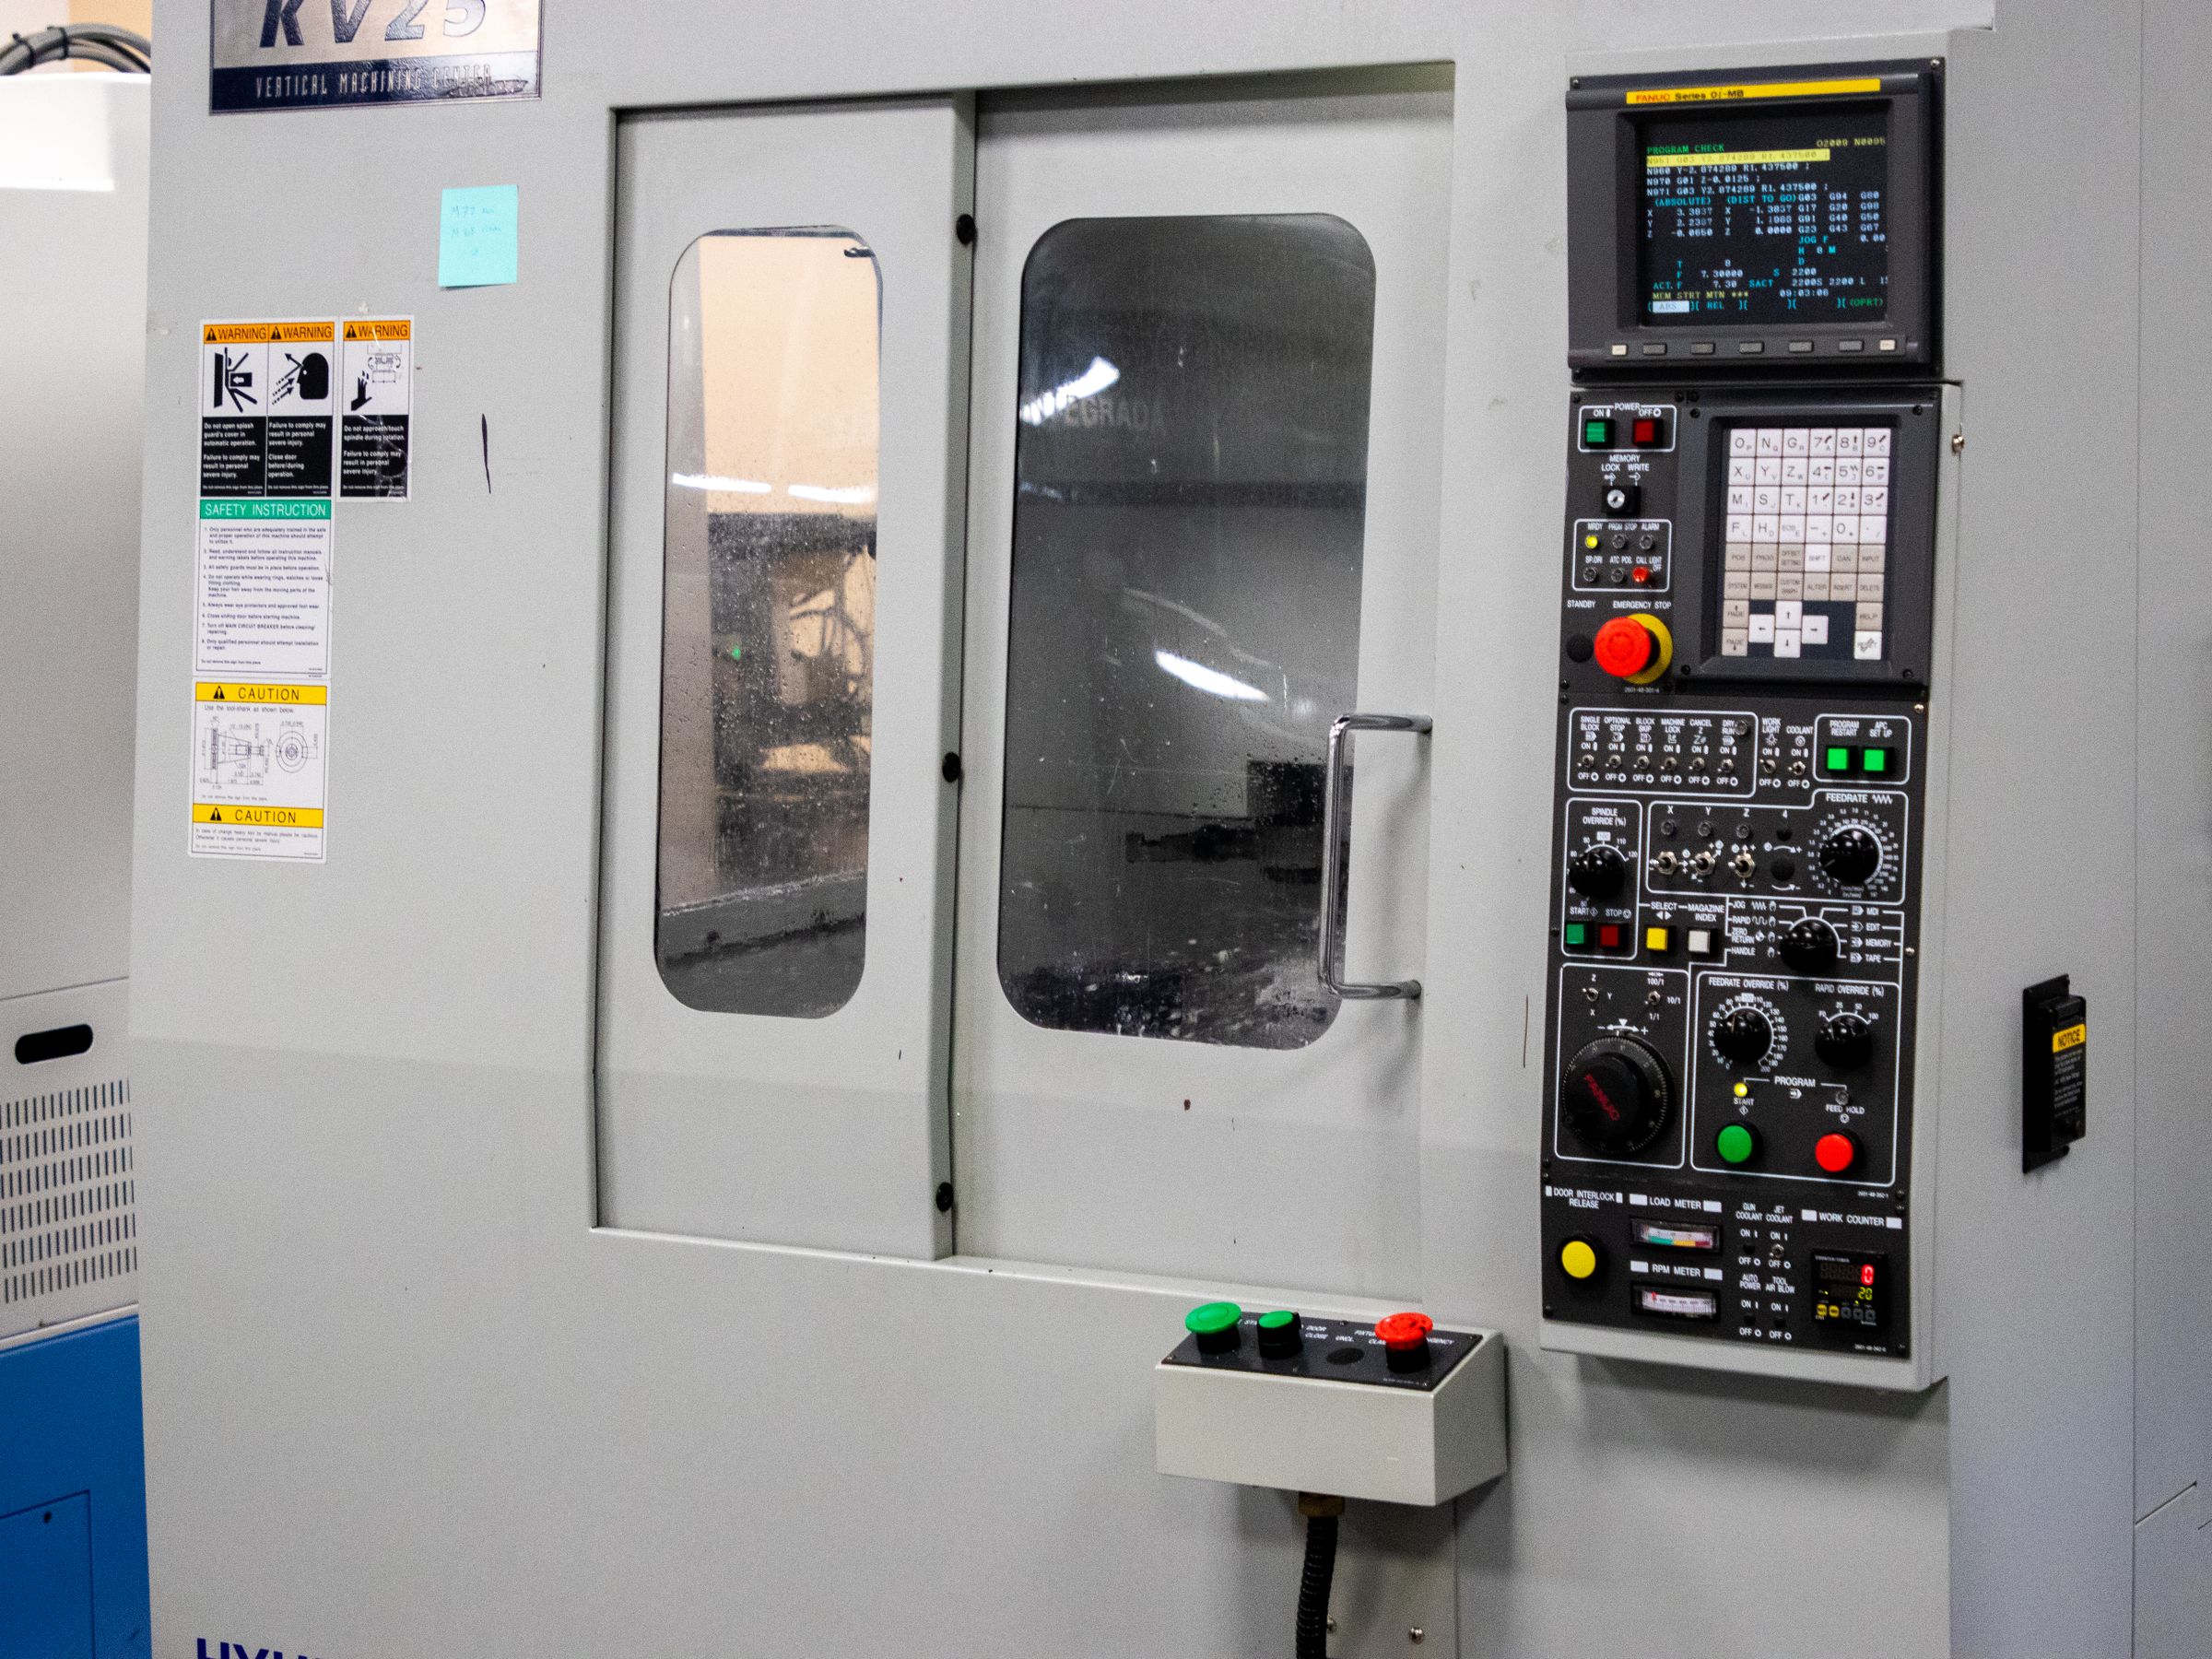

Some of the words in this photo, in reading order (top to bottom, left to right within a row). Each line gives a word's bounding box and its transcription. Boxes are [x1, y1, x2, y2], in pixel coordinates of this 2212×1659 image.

[255, 77, 328, 99] VERTICAL
[339, 70, 421, 93] MACHINING
[432, 65, 493, 88] CENTER
[1636, 93, 1670, 102] FANUC
[1676, 91, 1706, 101] Series
[1647, 145, 1688, 154] PROGRAM
[1695, 144, 1724, 152] CHECK
[1761, 194, 1774, 203] TO
[1823, 235, 1829, 243] F
[1749, 279, 1773, 288] SACT
[1659, 302, 1677, 311] ABS
[1707, 301, 1724, 310] REL
[218, 328, 266, 340] WARNING
[283, 325, 332, 338] WARNING
[359, 324, 408, 336] WARNING
[1615, 403, 1641, 411] POWER
[206, 503, 246, 516] SAFETY
[253, 504, 325, 516] INSTRUCTION
[239, 688, 300, 700] CAUTION
[1689, 719, 1712, 727] CANCEL
[1830, 721, 1859, 729] PROGRAM
[1762, 725, 1780, 734] LIGHT
[1786, 726, 1813, 735] COOLANT
[1831, 728, 1857, 736] RESTART
[1826, 794, 1867, 803] FEEDRATE
[1592, 808, 1618, 817] SPINDLE
[1667, 806, 1673, 814] X
[1706, 806, 1712, 815] Y
[235, 808, 296, 823] CAUTION
[1615, 818, 1626, 826] (%)
[1570, 907, 1590, 915] START
[1652, 902, 1677, 911] SELECT
[1731, 935, 1755, 944] RETURN
[1865, 954, 1881, 962] TAPE
[1648, 978, 1664, 986] 100/1
[1709, 977, 1740, 987] FEEDRATE
[1744, 979, 1774, 990] OVERRIDE
[1777, 982, 1789, 992] (%)
[1815, 984, 1834, 993] RAPID
[1837, 985, 1869, 996] OVERRIDE
[1872, 987, 1884, 997] (%)
[1667, 996, 1680, 1005] 10/1
[2058, 1030, 2080, 1047] NOTICE
[1775, 1077, 1816, 1087] PROGRAM
[1554, 1187, 1573, 1197] DOOR
[1577, 1191, 1615, 1201] INTERLOCK
[1569, 1199, 1599, 1209] RELEASE
[1650, 1197, 1670, 1206] LOAD
[1675, 1199, 1701, 1209] METER
[1743, 1203, 1756, 1211] GUN
[1774, 1206, 1784, 1214] JET
[1735, 1212, 1762, 1220] COOLANT
[1766, 1214, 1793, 1224] COOLANT
[1819, 1212, 1843, 1222] WORK
[1846, 1215, 1885, 1226] COUNTER
[1652, 1265, 1669, 1274] RPM
[1674, 1266, 1700, 1277] METER
[1742, 1274, 1758, 1282] AUTO
[1772, 1277, 1787, 1285] TOOL
[1739, 1281, 1761, 1290] POWER
[1778, 1285, 1795, 1294] BLOW
